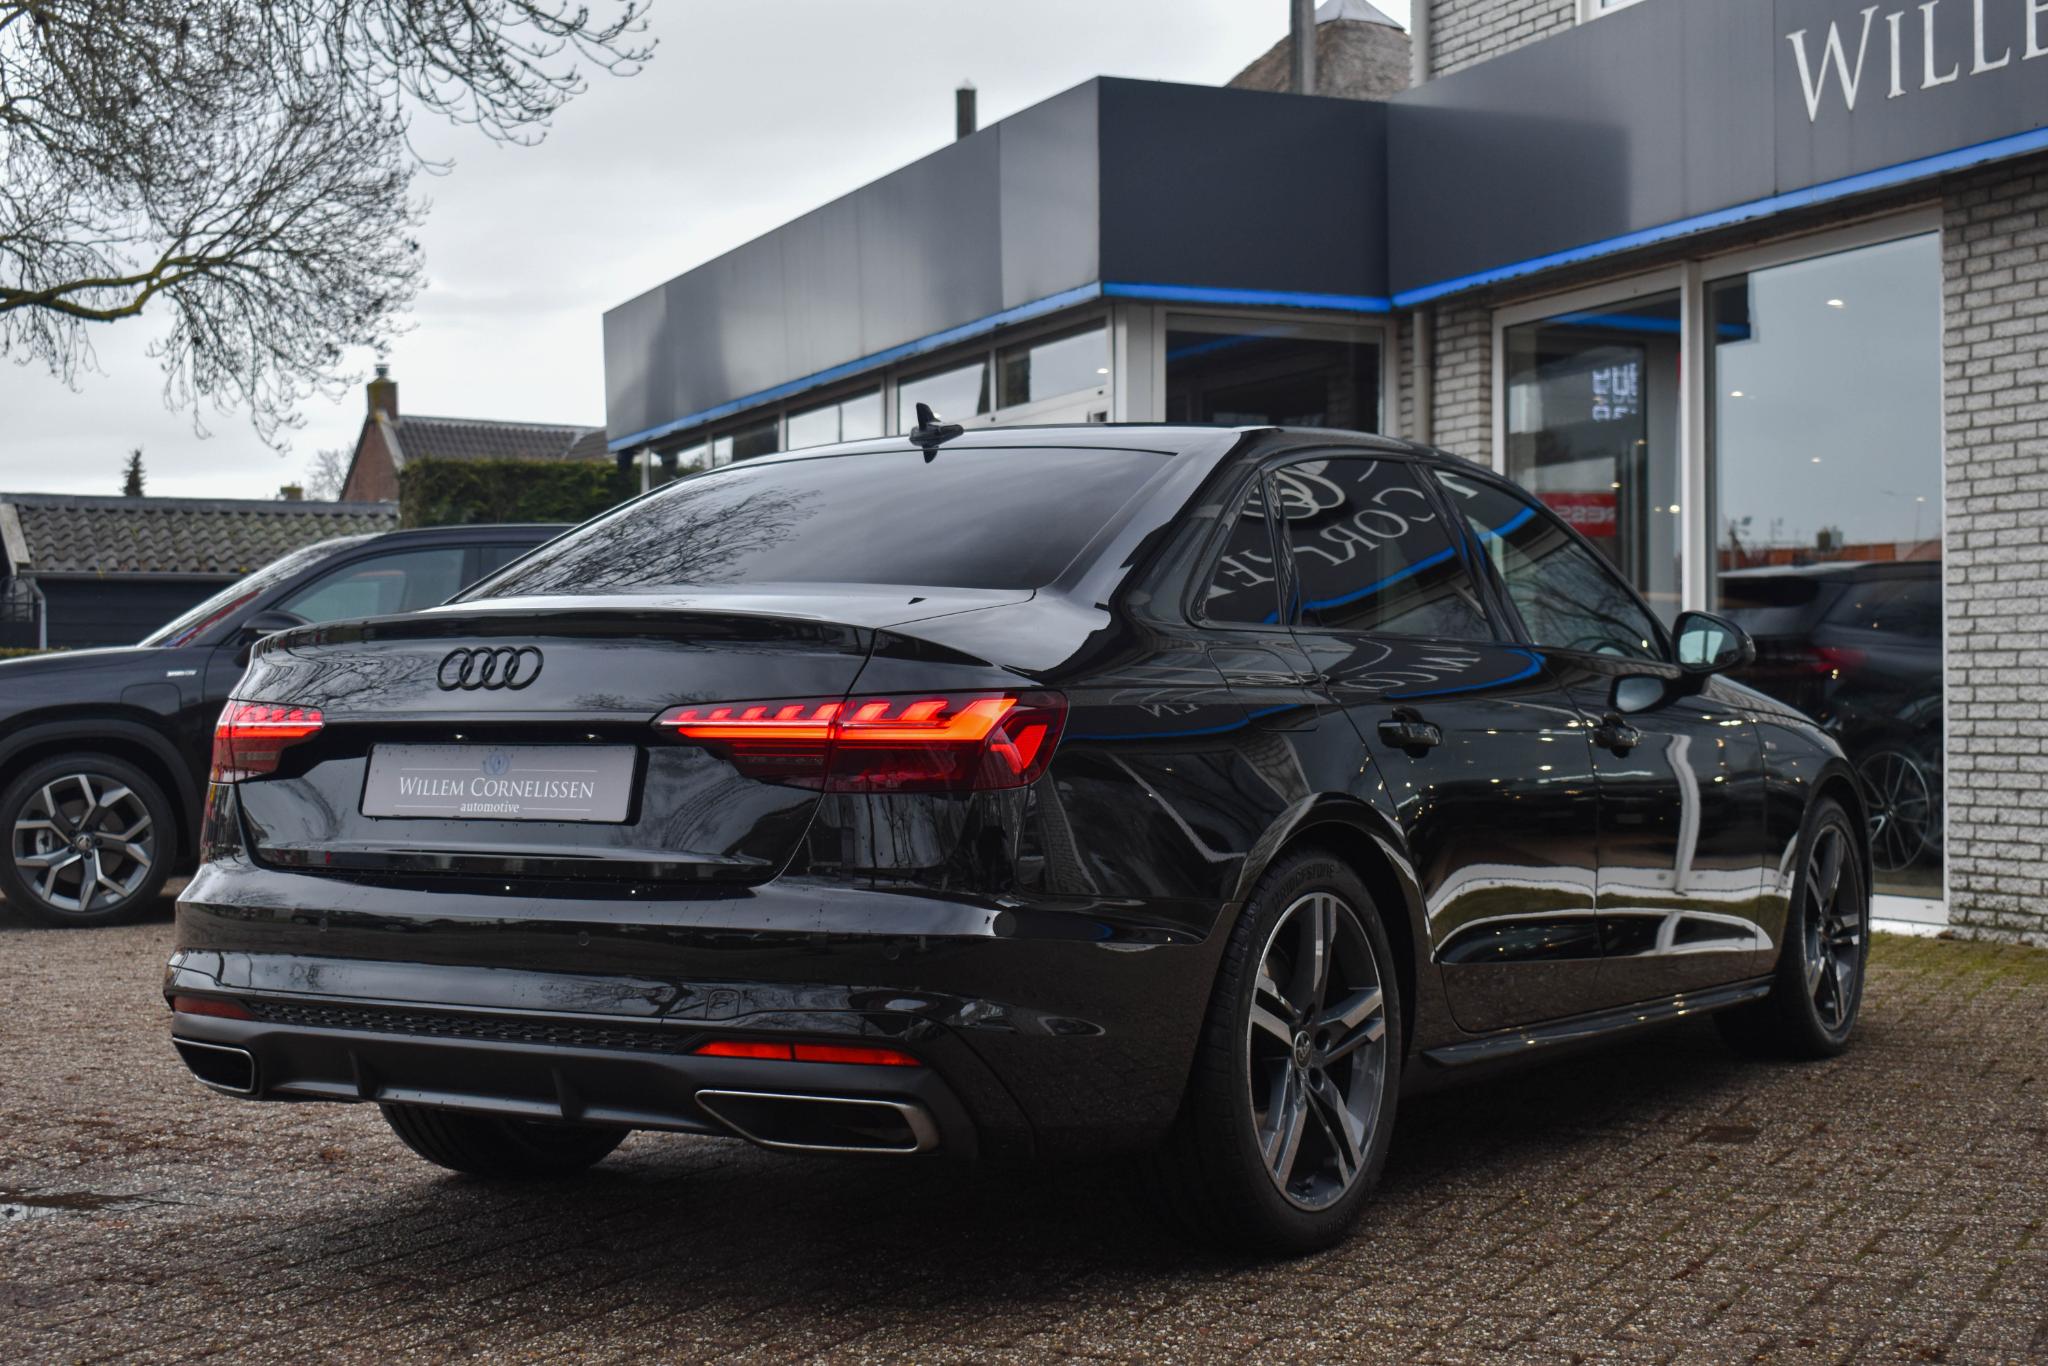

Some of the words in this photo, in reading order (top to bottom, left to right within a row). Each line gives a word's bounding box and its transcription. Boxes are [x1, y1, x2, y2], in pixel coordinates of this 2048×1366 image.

[400, 777, 464, 797] WILLEM
[470, 777, 595, 800] CORNELISSEN
[459, 801, 520, 813] automotive
